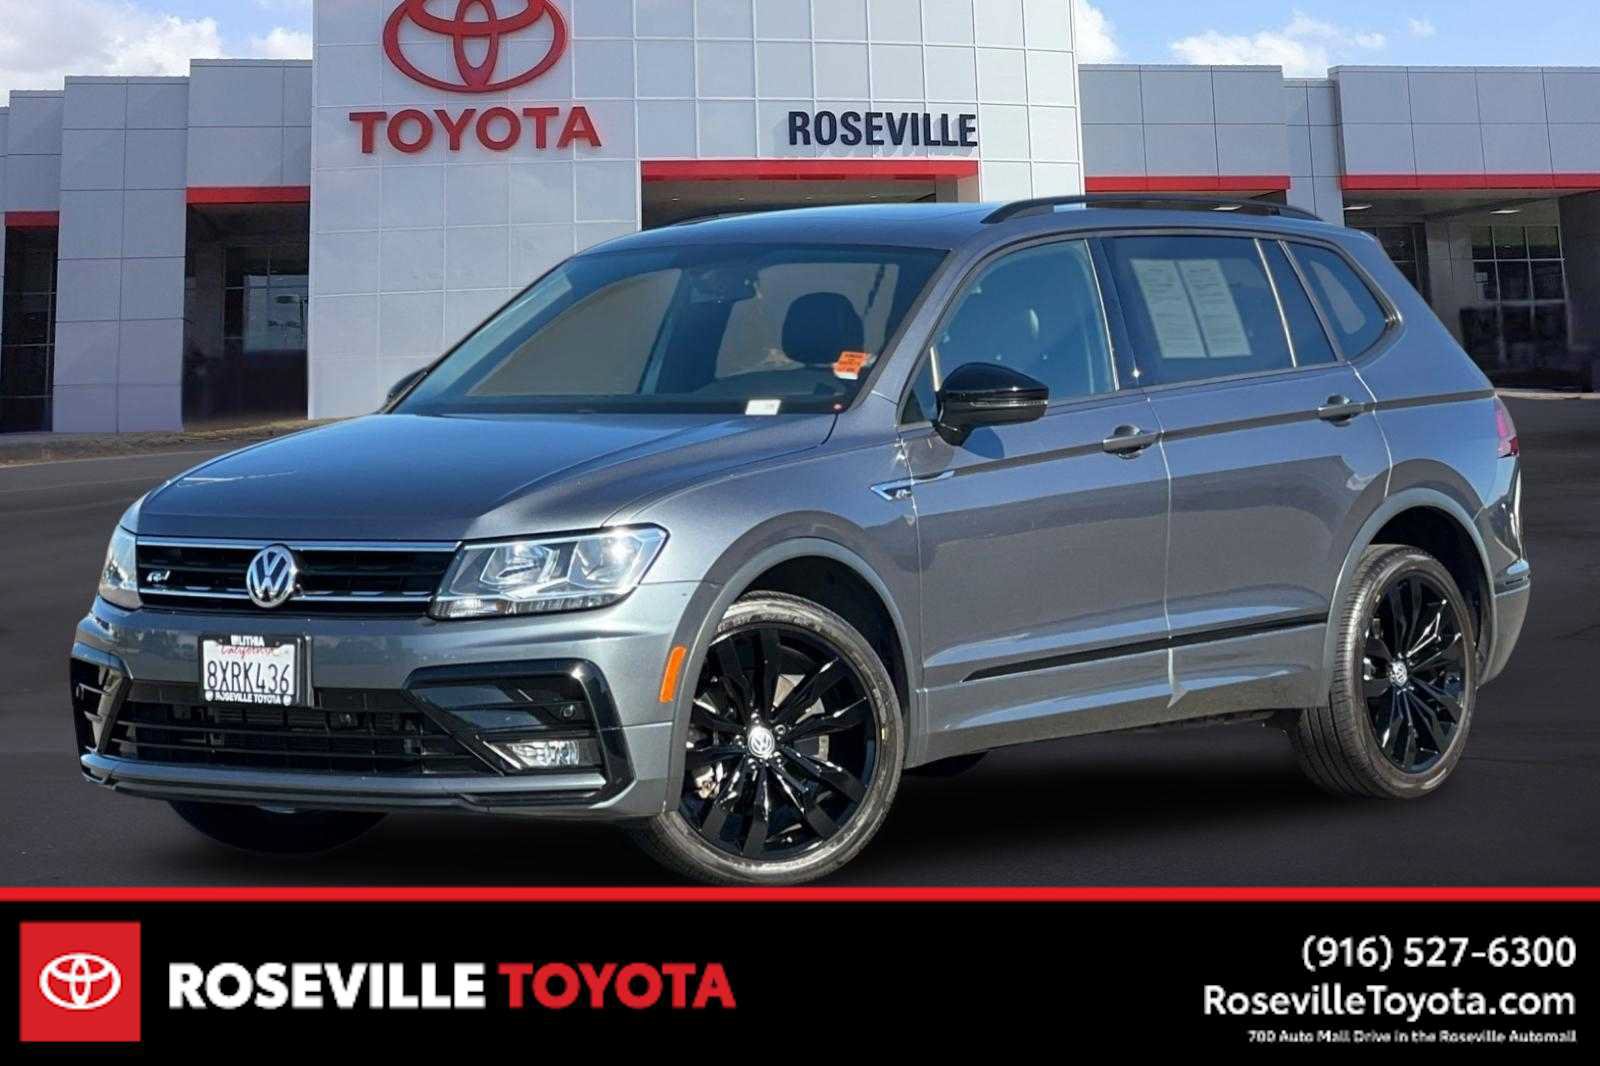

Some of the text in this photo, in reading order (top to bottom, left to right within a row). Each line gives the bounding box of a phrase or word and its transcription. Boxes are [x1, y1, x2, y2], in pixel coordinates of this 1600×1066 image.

[349, 106, 603, 154] TOYOTA
[788, 110, 979, 147] ROSEVILLE
[207, 661, 290, 694] 8XRK436
